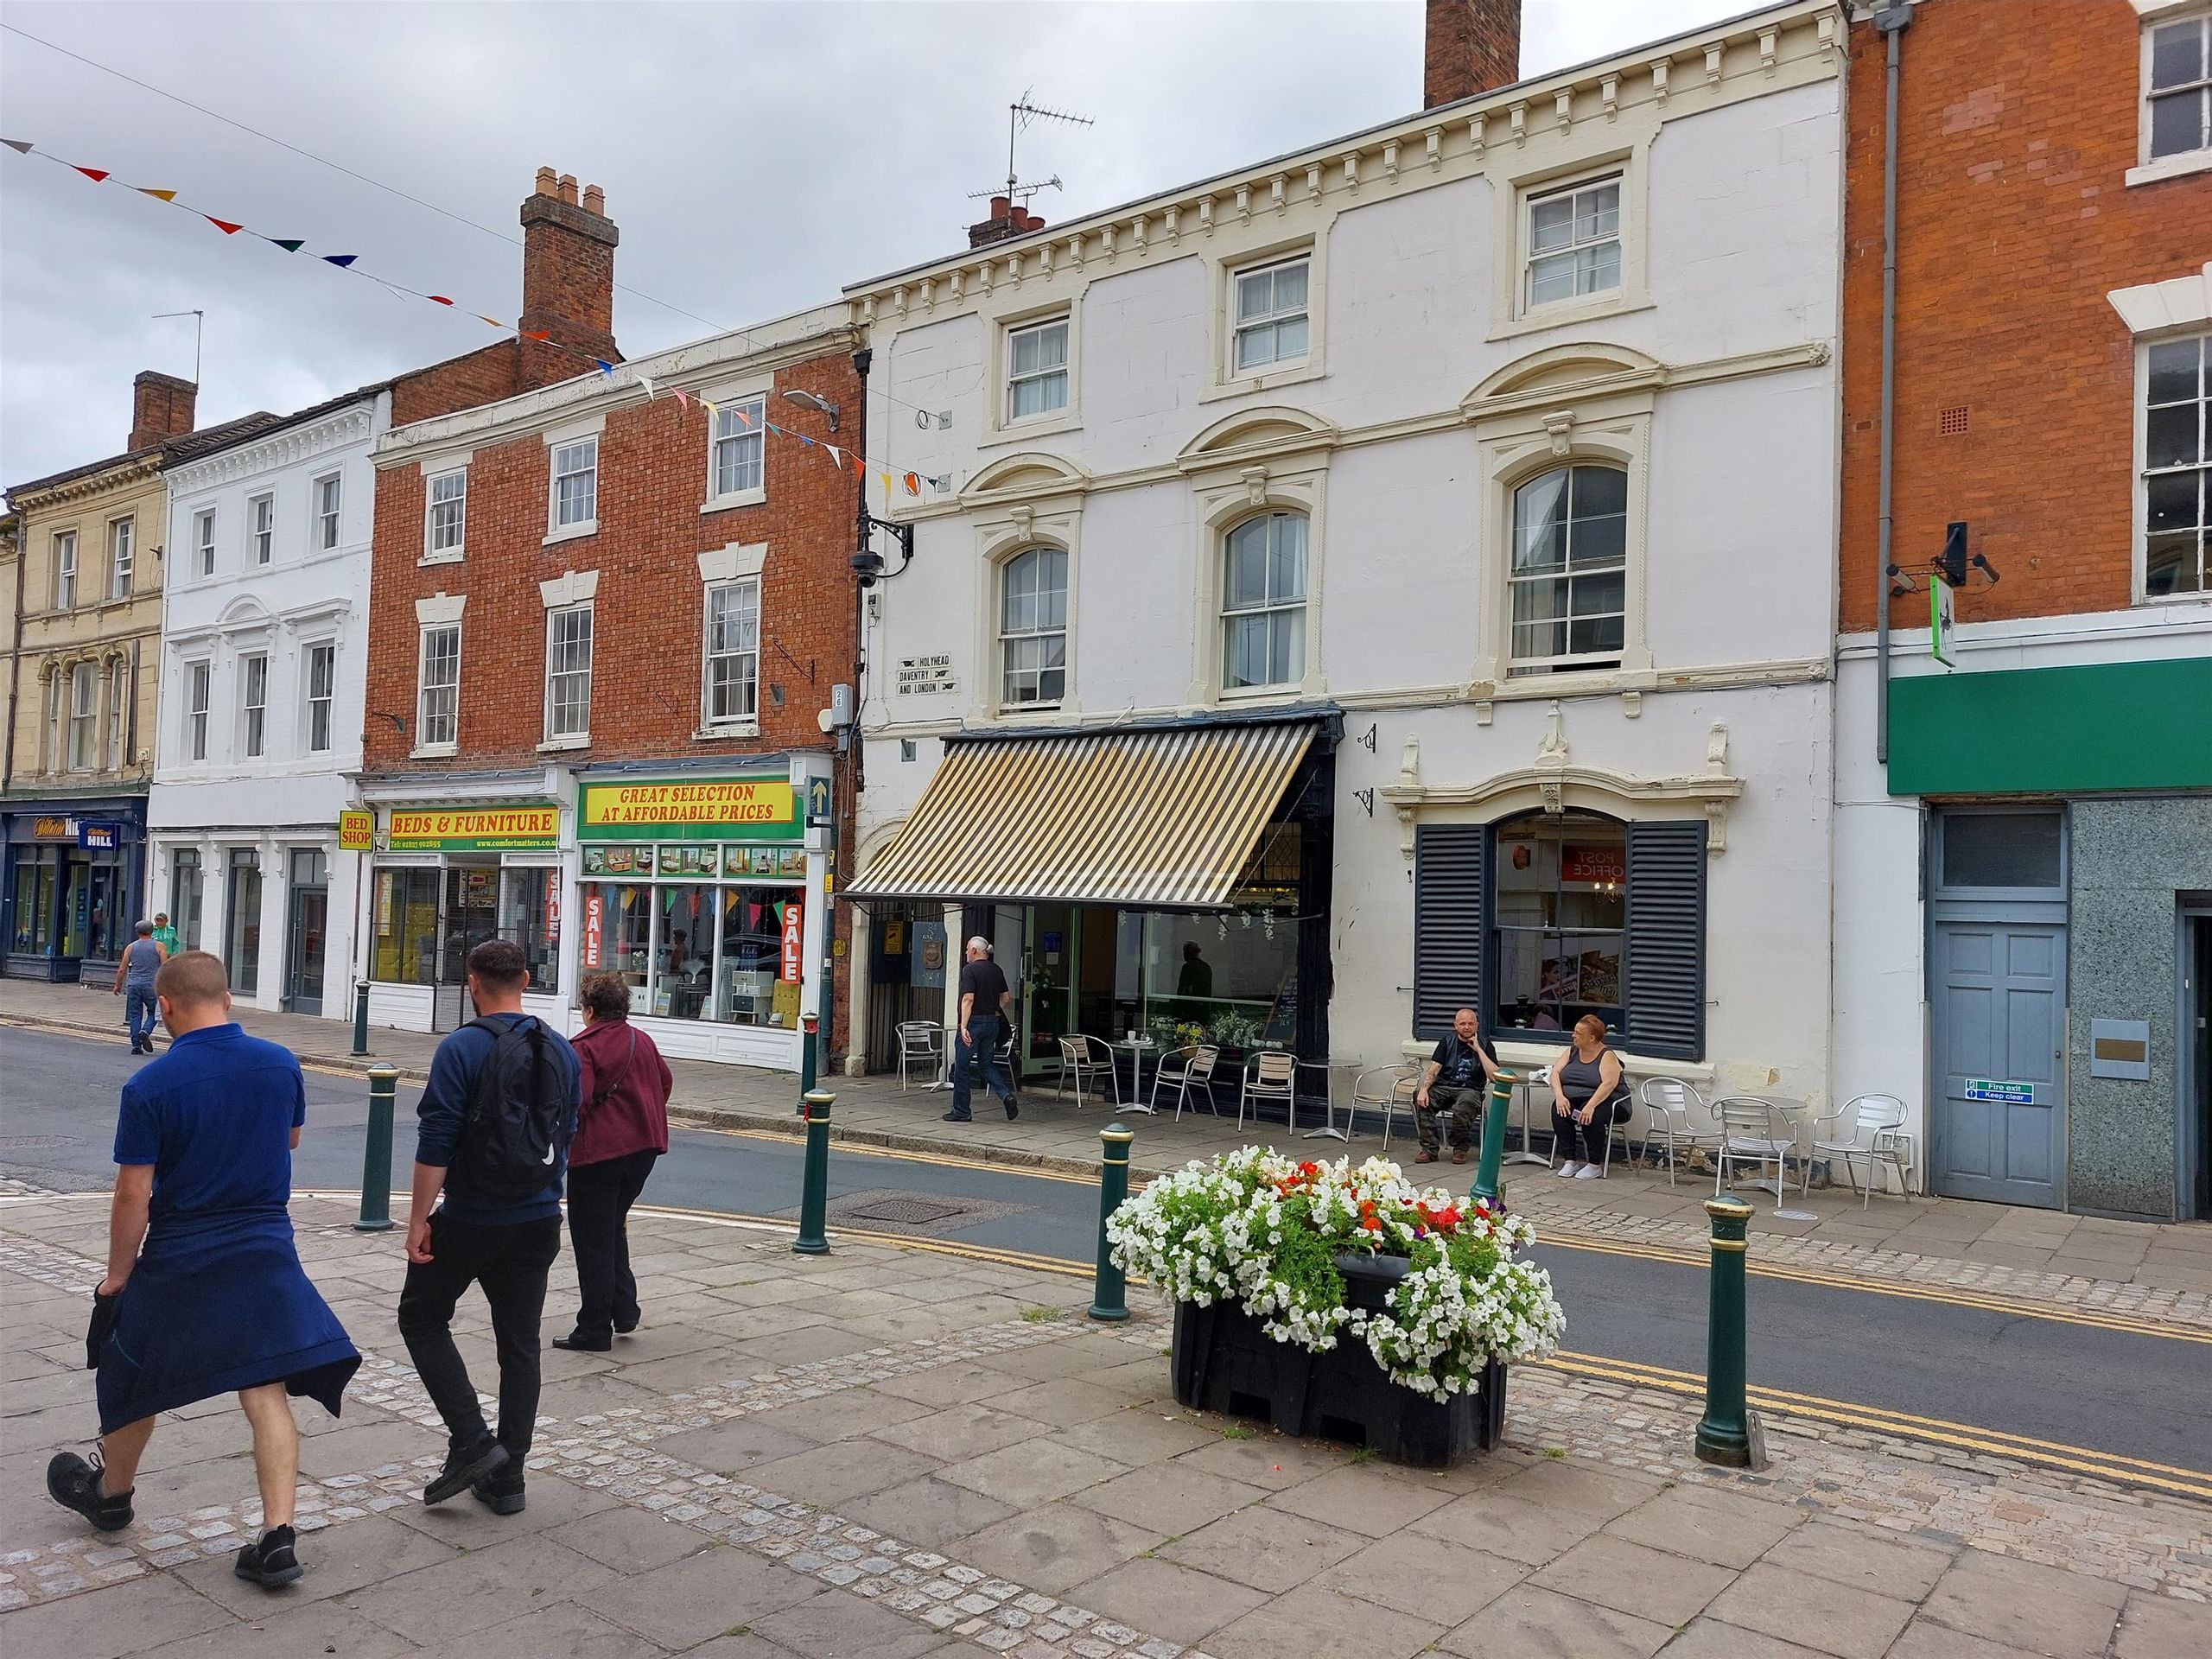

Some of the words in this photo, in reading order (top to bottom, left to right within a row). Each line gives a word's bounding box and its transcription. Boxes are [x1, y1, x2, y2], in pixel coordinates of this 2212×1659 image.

[919, 655, 950, 667] HOLYHEAD
[899, 670, 930, 682] DAVENTRY
[899, 684, 912, 695] AND
[914, 683, 937, 694] LONDON
[836, 690, 842, 706] 26
[620, 787, 669, 804] GREAT
[671, 785, 756, 803] SELECTION
[601, 807, 620, 822] AT
[622, 805, 716, 821] AFFORDABLE
[718, 804, 774, 820] PRICES
[65, 817, 79, 836] HIL
[346, 817, 368, 830] BED
[392, 817, 433, 834] BEDS
[435, 817, 451, 833] &
[454, 814, 553, 833] FURNITURE
[87, 836, 112, 847] HILL
[341, 830, 372, 844] SHOP
[476, 838, 558, 848] www.comfortmatters.co.u
[587, 899, 599, 965] SALE
[784, 906, 799, 981] SALE
[1985, 1091, 2005, 1100] Keep
